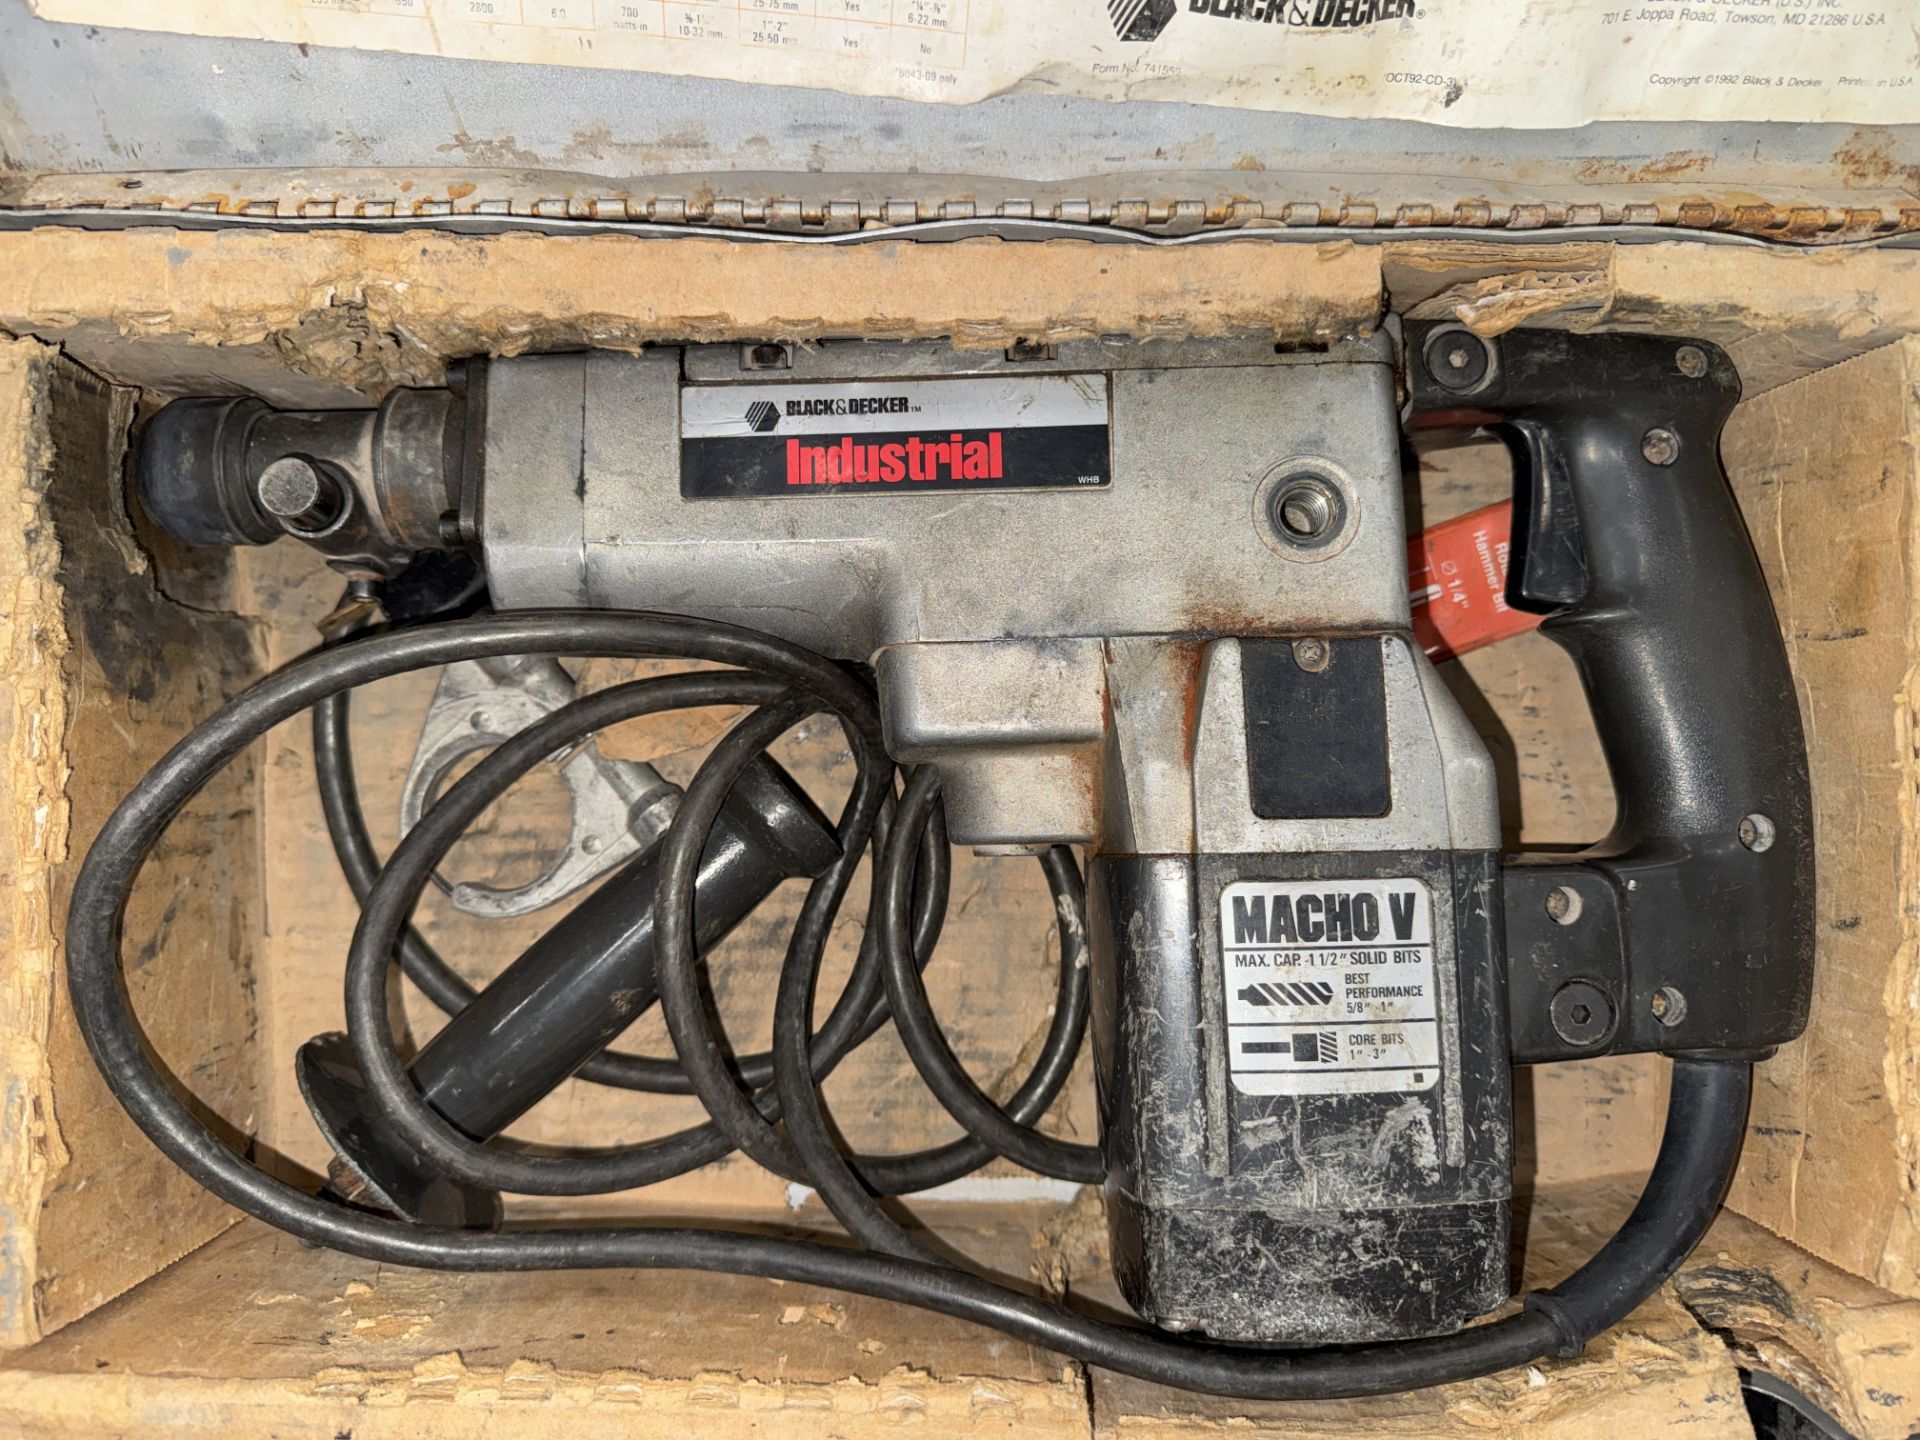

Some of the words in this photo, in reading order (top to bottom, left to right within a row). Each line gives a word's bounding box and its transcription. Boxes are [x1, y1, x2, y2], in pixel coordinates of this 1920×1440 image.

[469, 2, 494, 14] 2800
[622, 6, 639, 18] 700
[783, 2, 799, 11] mm
[845, 1, 860, 11] Yes
[908, 13, 929, 25] 6-22
[931, 18, 948, 28] mm
[1602, 12, 1620, 25] 701
[1636, 8, 1675, 22] Joppa
[1680, 8, 1717, 24] Road,
[1725, 11, 1776, 26] Towson,
[1783, 13, 1806, 25] MD
[1808, 13, 1849, 26] 21286
[679, 25, 704, 37] 10-32
[752, 31, 779, 44] 25-50
[843, 37, 858, 48] Yes
[920, 44, 932, 55] No
[1092, 63, 1119, 74] Form
[939, 73, 957, 86] only
[1649, 73, 1701, 88] Copyright
[1742, 75, 1772, 86] Black
[1775, 76, 1784, 87] &
[1787, 77, 1824, 87] Decker
[786, 432, 1003, 485] Industrial
[1078, 475, 1100, 484] WHB
[1472, 529, 1500, 590] Hammer
[1448, 579, 1470, 609] 1/4"
[1232, 892, 1380, 944] MACHO
[1388, 892, 1416, 941] V
[1234, 953, 1270, 967] MAX.
[1273, 953, 1301, 967] CAP.
[1350, 951, 1388, 965] SOLID
[1394, 950, 1422, 963] BITS
[1344, 973, 1371, 984] BEST
[1345, 985, 1424, 999] PERFORMANCE
[1349, 1034, 1377, 1046] CORE
[1381, 1033, 1405, 1045] BITS
